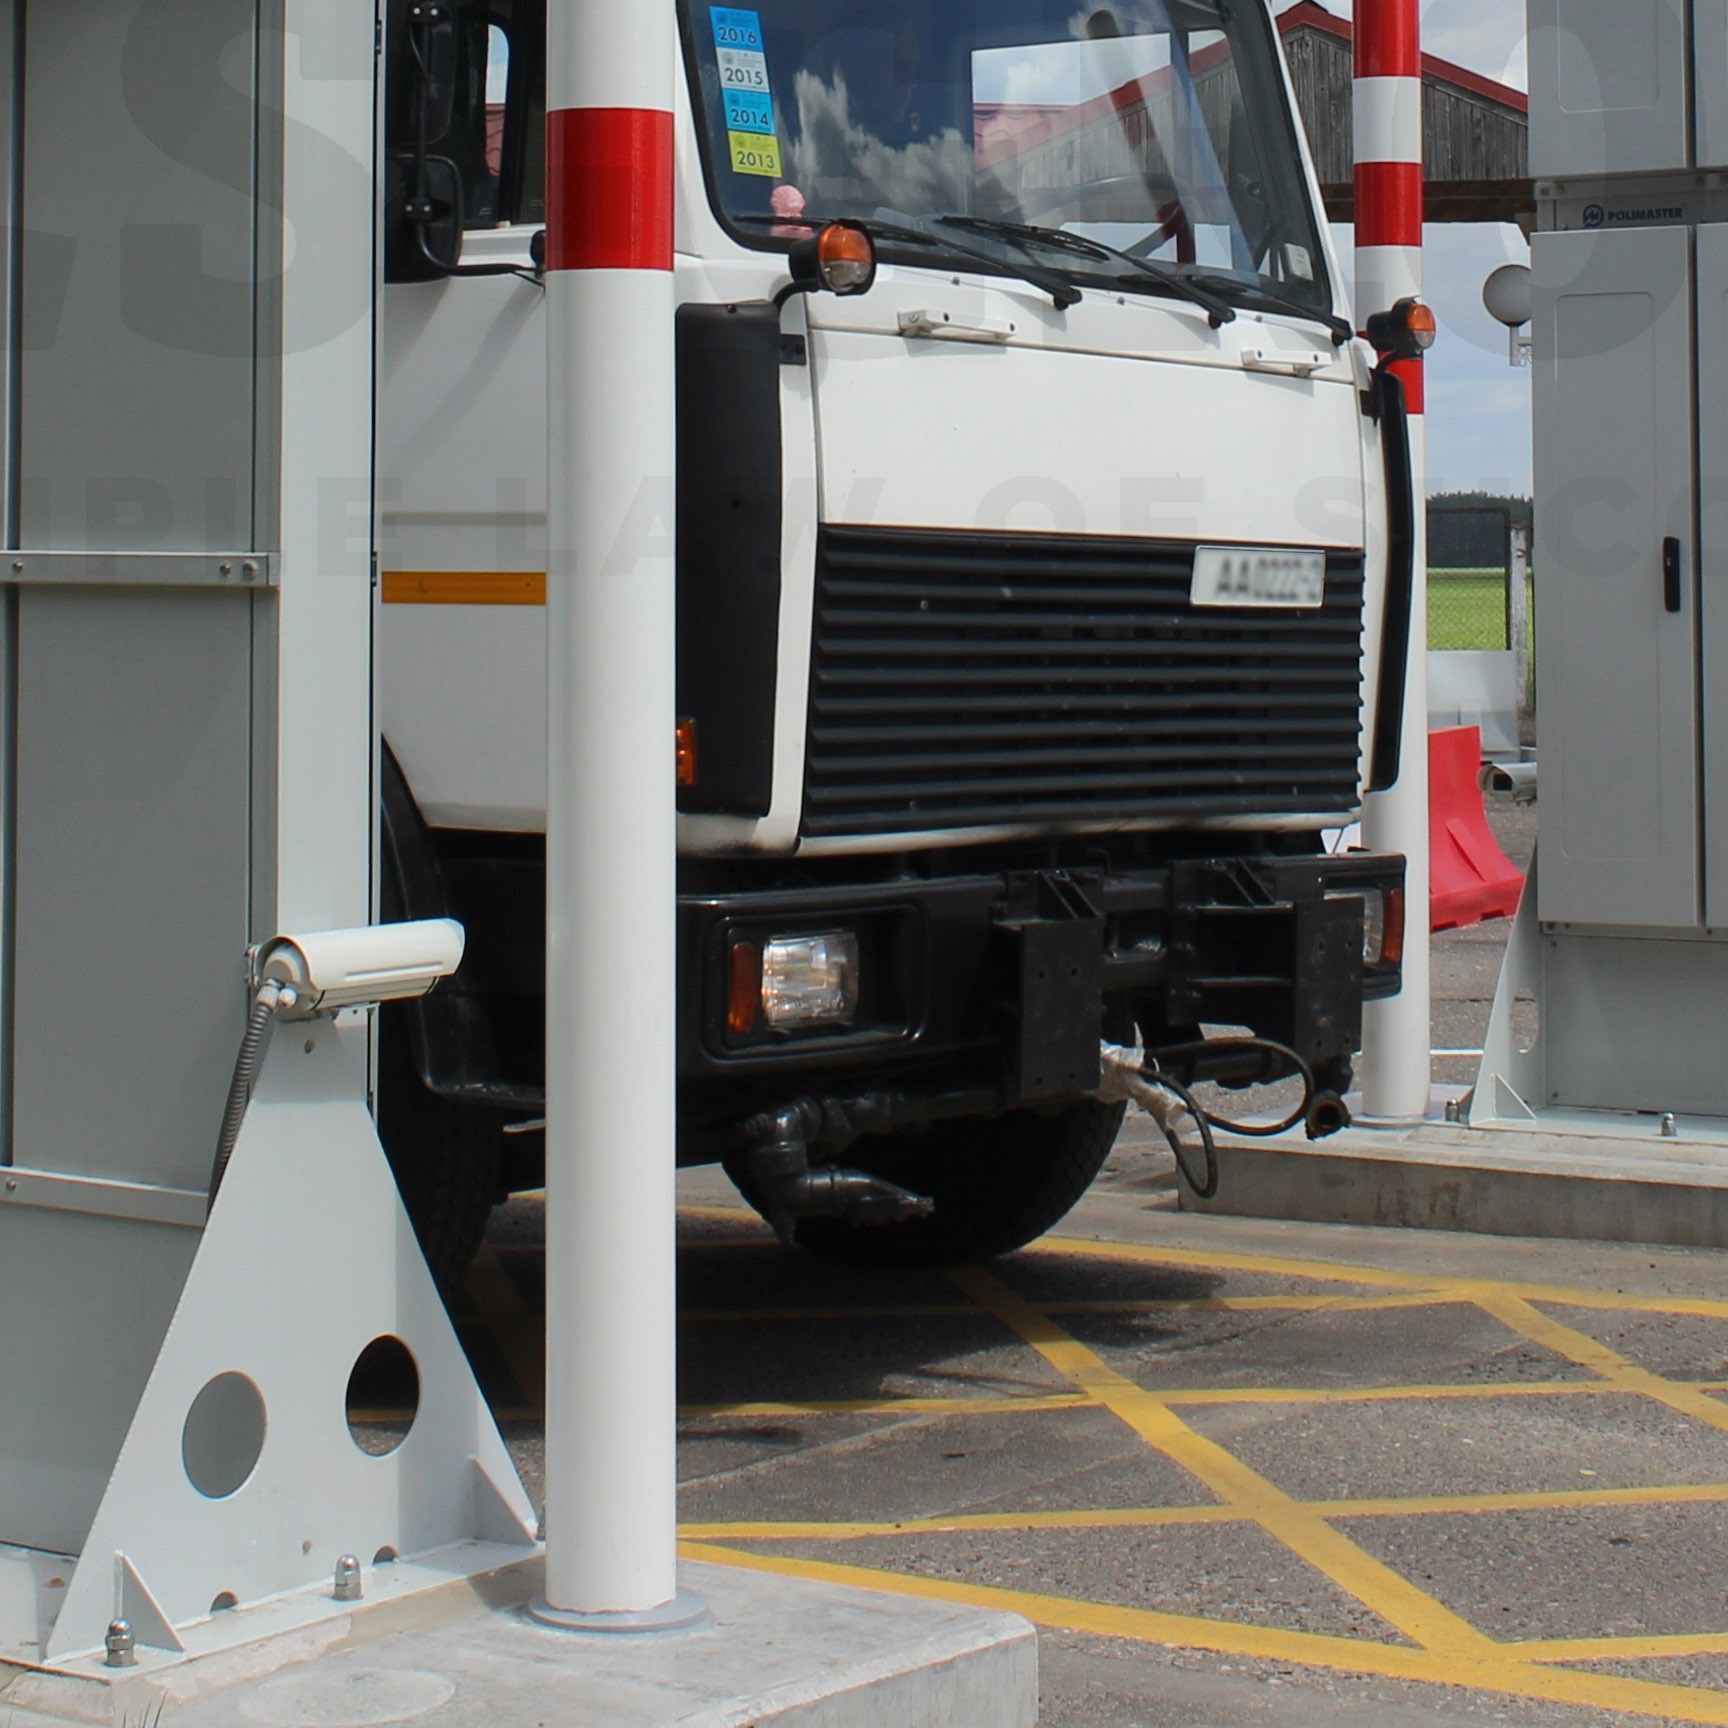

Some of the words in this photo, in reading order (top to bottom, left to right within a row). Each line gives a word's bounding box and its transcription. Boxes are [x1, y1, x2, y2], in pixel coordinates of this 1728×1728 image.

[718, 27, 756, 44] 2016
[725, 68, 764, 85] 2015
[731, 108, 769, 126] 2014
[737, 150, 775, 169] 2013
[1608, 207, 1684, 222] POLIMASTER
